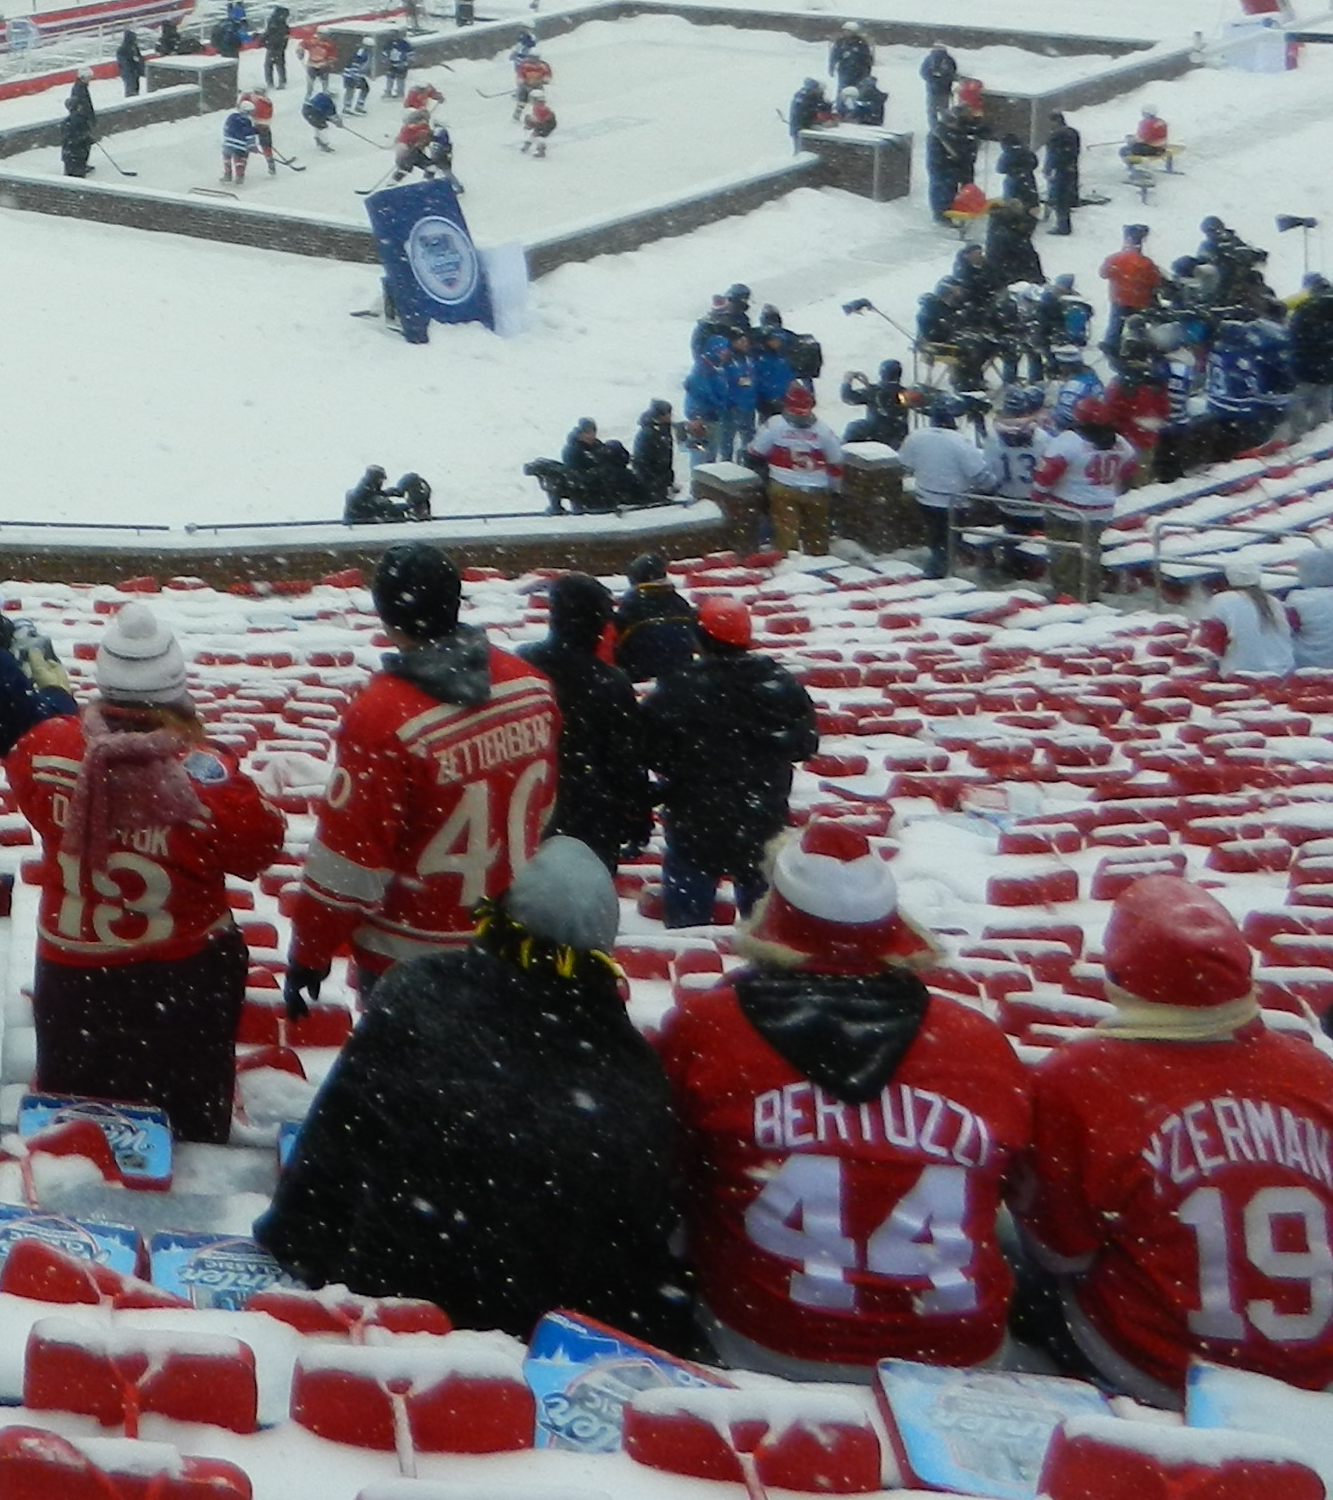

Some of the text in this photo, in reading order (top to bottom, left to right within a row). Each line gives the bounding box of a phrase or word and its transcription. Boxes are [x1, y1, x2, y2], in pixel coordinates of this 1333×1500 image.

[1000, 453, 1034, 484] 13
[1084, 453, 1122, 487] 40
[52, 793, 173, 858] DYUK
[56, 851, 174, 947] 13
[752, 1080, 993, 1168] BERTUZZI
[1141, 1097, 1333, 1195] YZERMAN
[743, 1153, 979, 1316] 44
[1177, 1186, 1333, 1343] 19
